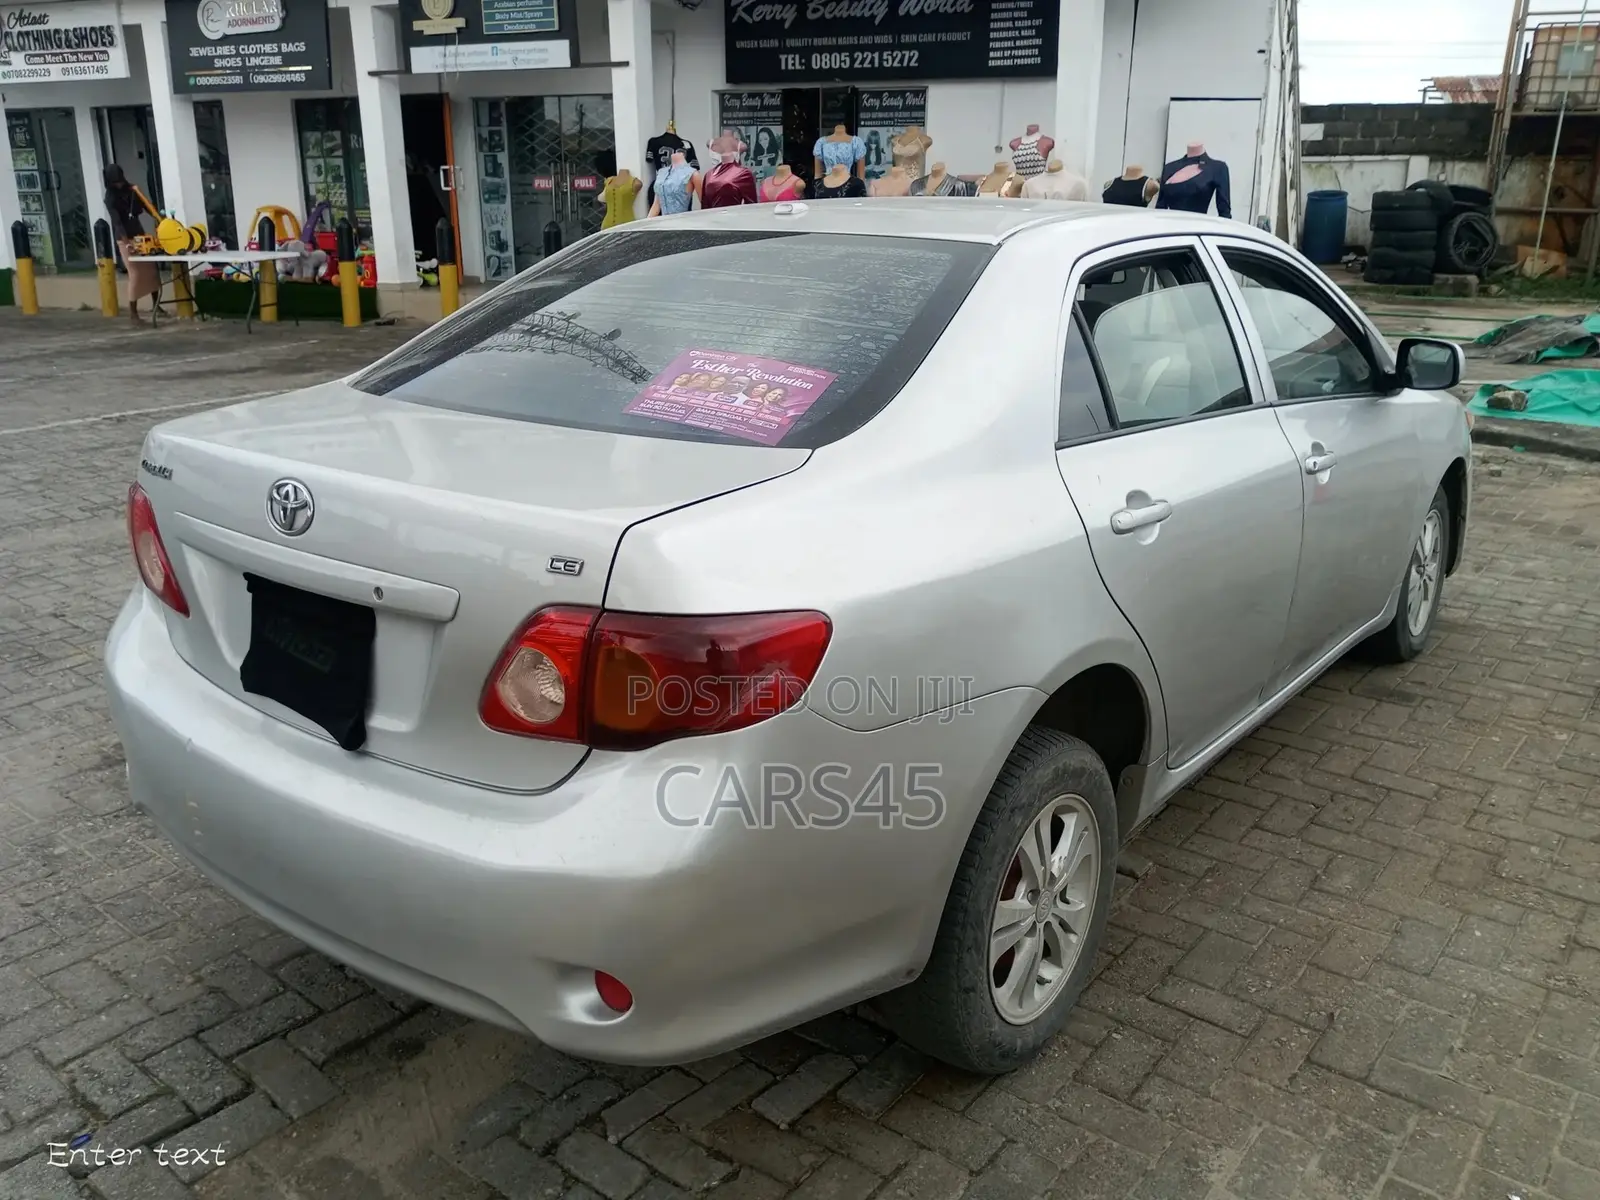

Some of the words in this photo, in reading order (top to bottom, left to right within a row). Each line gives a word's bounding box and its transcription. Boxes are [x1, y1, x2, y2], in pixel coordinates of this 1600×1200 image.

[227, 15, 276, 29] ADORNMENTS
[730, 0, 798, 29] Kerry
[806, 0, 889, 26] Beauty
[188, 45, 236, 57] JEWELRIES
[239, 43, 278, 55] CLOTHES
[281, 42, 306, 53] BAGS
[25, 54, 45, 64] Come
[45, 54, 63, 64] Meet
[63, 53, 77, 63] The
[77, 52, 94, 62] New
[94, 51, 109, 61] You
[214, 57, 243, 68] SHOES
[245, 56, 283, 66] LINGERIE
[779, 54, 806, 71] TEL:
[811, 52, 850, 70] 0805
[853, 51, 879, 68] 221
[882, 50, 919, 68] 5272
[574, 178, 594, 188] PULL
[690, 359, 745, 375] Esther
[747, 367, 814, 390] Revolution
